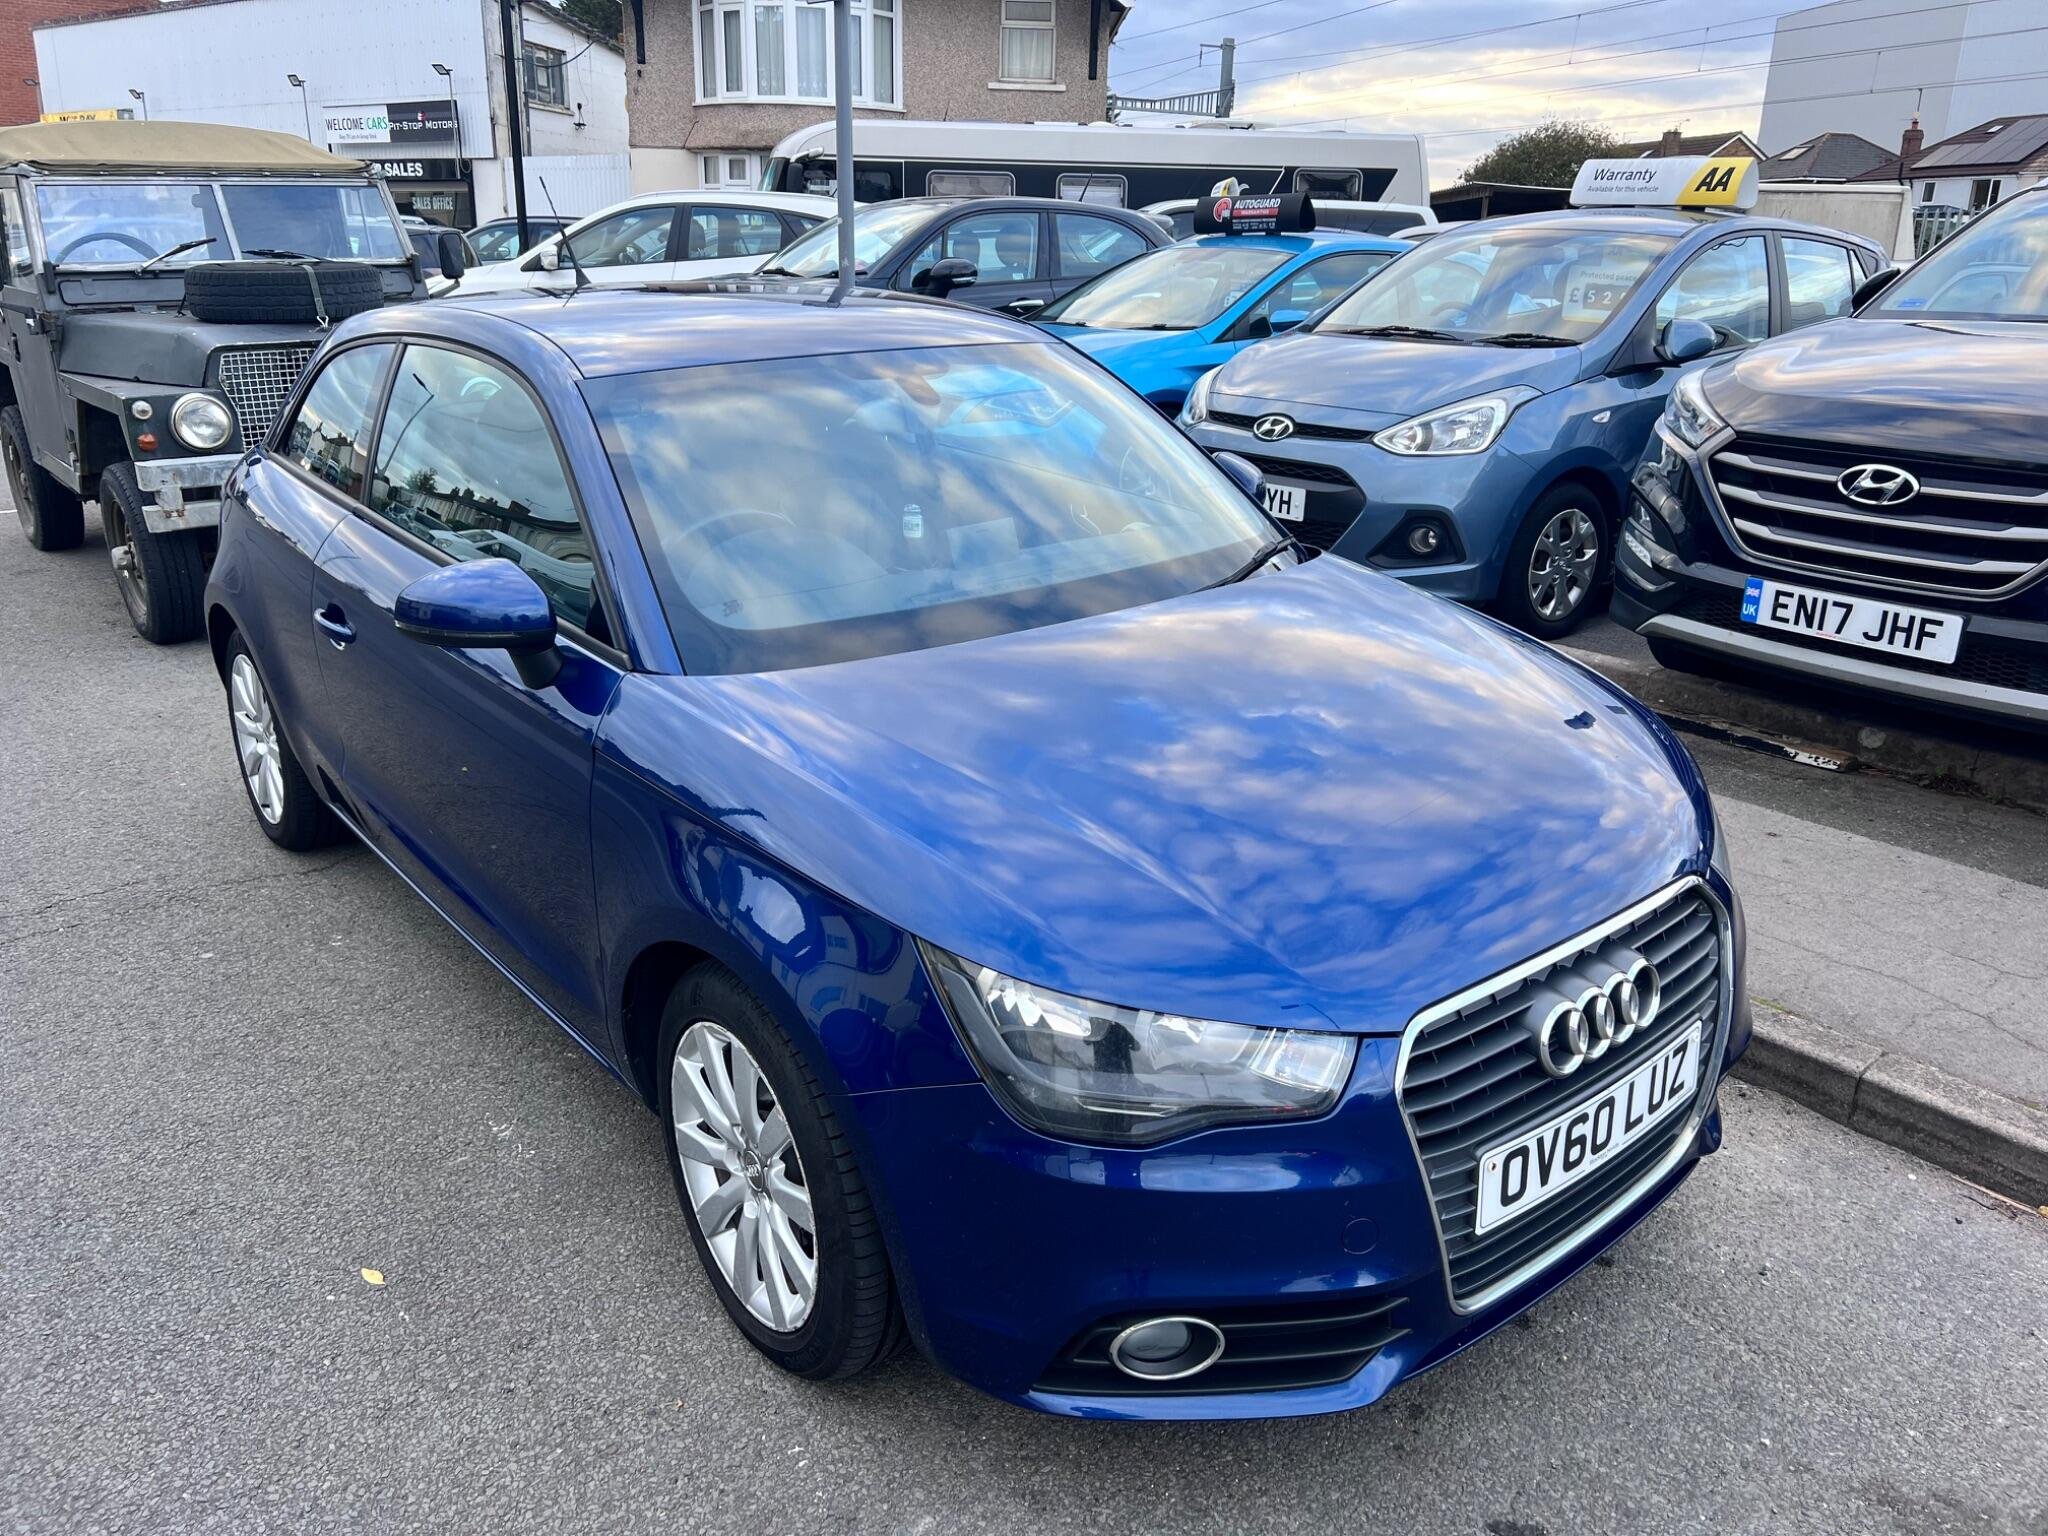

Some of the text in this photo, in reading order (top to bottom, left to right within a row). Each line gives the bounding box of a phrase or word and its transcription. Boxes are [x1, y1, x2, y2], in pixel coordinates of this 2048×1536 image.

[325, 116, 388, 131] WELCOME CARS
[388, 120, 458, 131] PIT-STOP MOTORS
[384, 162, 424, 177] SALES
[1593, 167, 1735, 192] Warranty AA
[1587, 185, 1659, 193] Available for this vehicle
[411, 196, 454, 211] SALES OFFICE
[1234, 198, 1281, 209] AUTOGUARD
[1267, 488, 1292, 515] YH
[1742, 602, 1757, 616] UK
[1770, 589, 1945, 651] EN17 JHF
[1500, 1039, 1689, 1208] OV60 LUZ
